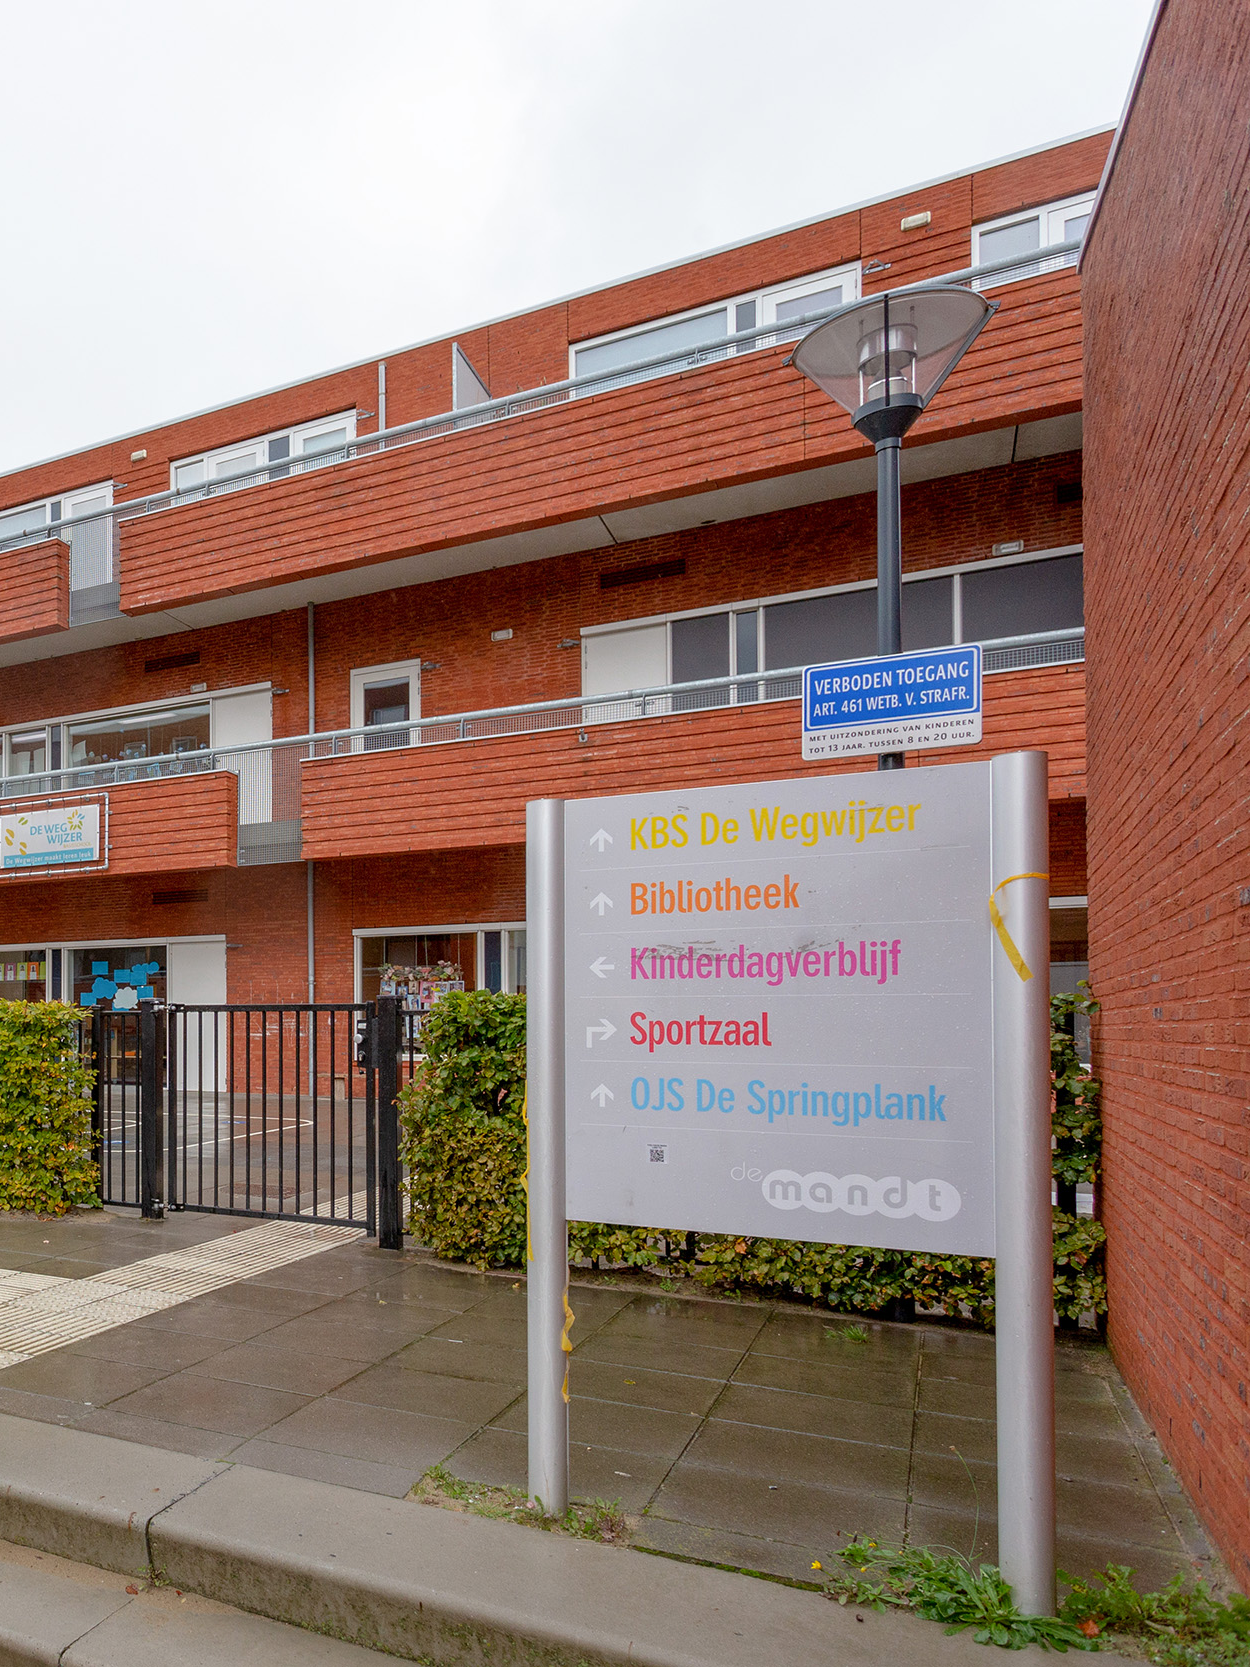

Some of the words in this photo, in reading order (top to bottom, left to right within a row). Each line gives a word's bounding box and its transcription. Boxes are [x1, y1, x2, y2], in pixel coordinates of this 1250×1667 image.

[814, 671, 892, 696] VERBODEN
[896, 661, 969, 685] TOEGANG
[813, 701, 838, 717] ART.
[841, 698, 862, 714] 461
[866, 694, 902, 711] WETB.
[905, 692, 917, 706] V.
[920, 686, 970, 705] STRAFR.
[809, 734, 827, 743] MET
[830, 726, 899, 740] UITZONDERING
[902, 724, 921, 733] VAN
[925, 718, 975, 730] KINDEREN
[809, 746, 825, 754] TOT
[828, 744, 838, 752] 13
[869, 739, 903, 748] TUSSEN
[907, 735, 914, 744] 8
[933, 732, 947, 741] 20
[952, 731, 975, 739] UUR.
[30, 825, 42, 836] DE
[44, 823, 67, 834] WEG
[47, 832, 82, 845] WIJZER
[629, 813, 689, 851] KBS
[700, 811, 739, 847] De
[750, 800, 921, 847] Wegwijzer
[15, 856, 43, 864] Wegwijzer
[63, 852, 78, 860] leren
[630, 874, 800, 916] Bibliotheek
[630, 940, 901, 986] Kinderdagverblijf
[630, 1012, 772, 1052] Sportzaal
[631, 1077, 685, 1113] OJS
[696, 1079, 735, 1113] De
[747, 1080, 947, 1127] Springplank
[730, 1162, 763, 1182] de
[768, 1175, 943, 1212] mandt
